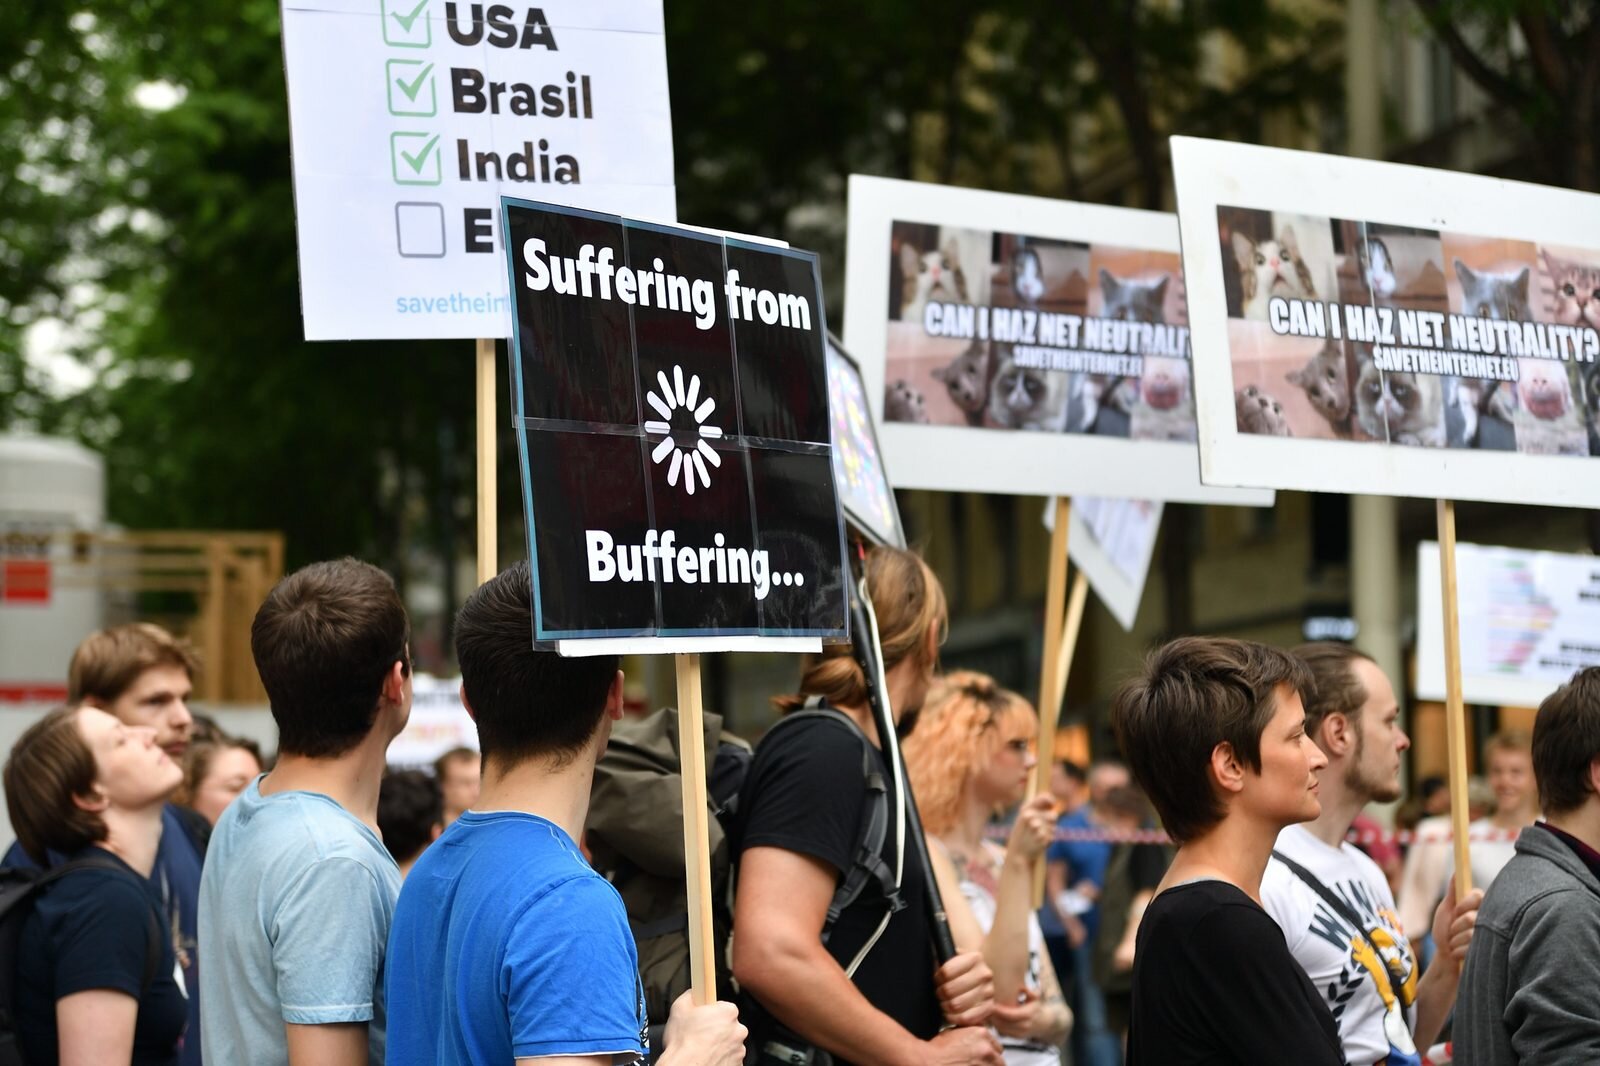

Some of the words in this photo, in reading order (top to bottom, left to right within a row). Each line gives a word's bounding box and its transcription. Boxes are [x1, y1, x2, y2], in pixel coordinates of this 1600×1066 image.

[446, 2, 559, 52] USA
[450, 67, 593, 119] Brasil
[456, 138, 581, 185] India
[463, 207, 505, 253] E
[522, 237, 716, 330] Suffering
[724, 268, 812, 331] from
[925, 301, 975, 338] CAN
[978, 306, 989, 340] I
[992, 307, 1037, 344] HAZ
[1038, 312, 1082, 348] NET
[1269, 297, 1326, 337] CAN
[1329, 302, 1341, 339] I
[1345, 304, 1395, 345] HAZ
[1398, 309, 1444, 348] NET
[1449, 313, 1600, 362] NEUTRALITY?
[1373, 345, 1519, 381] SAVETHEINTERNET.EU
[585, 529, 804, 600] Buffering...
